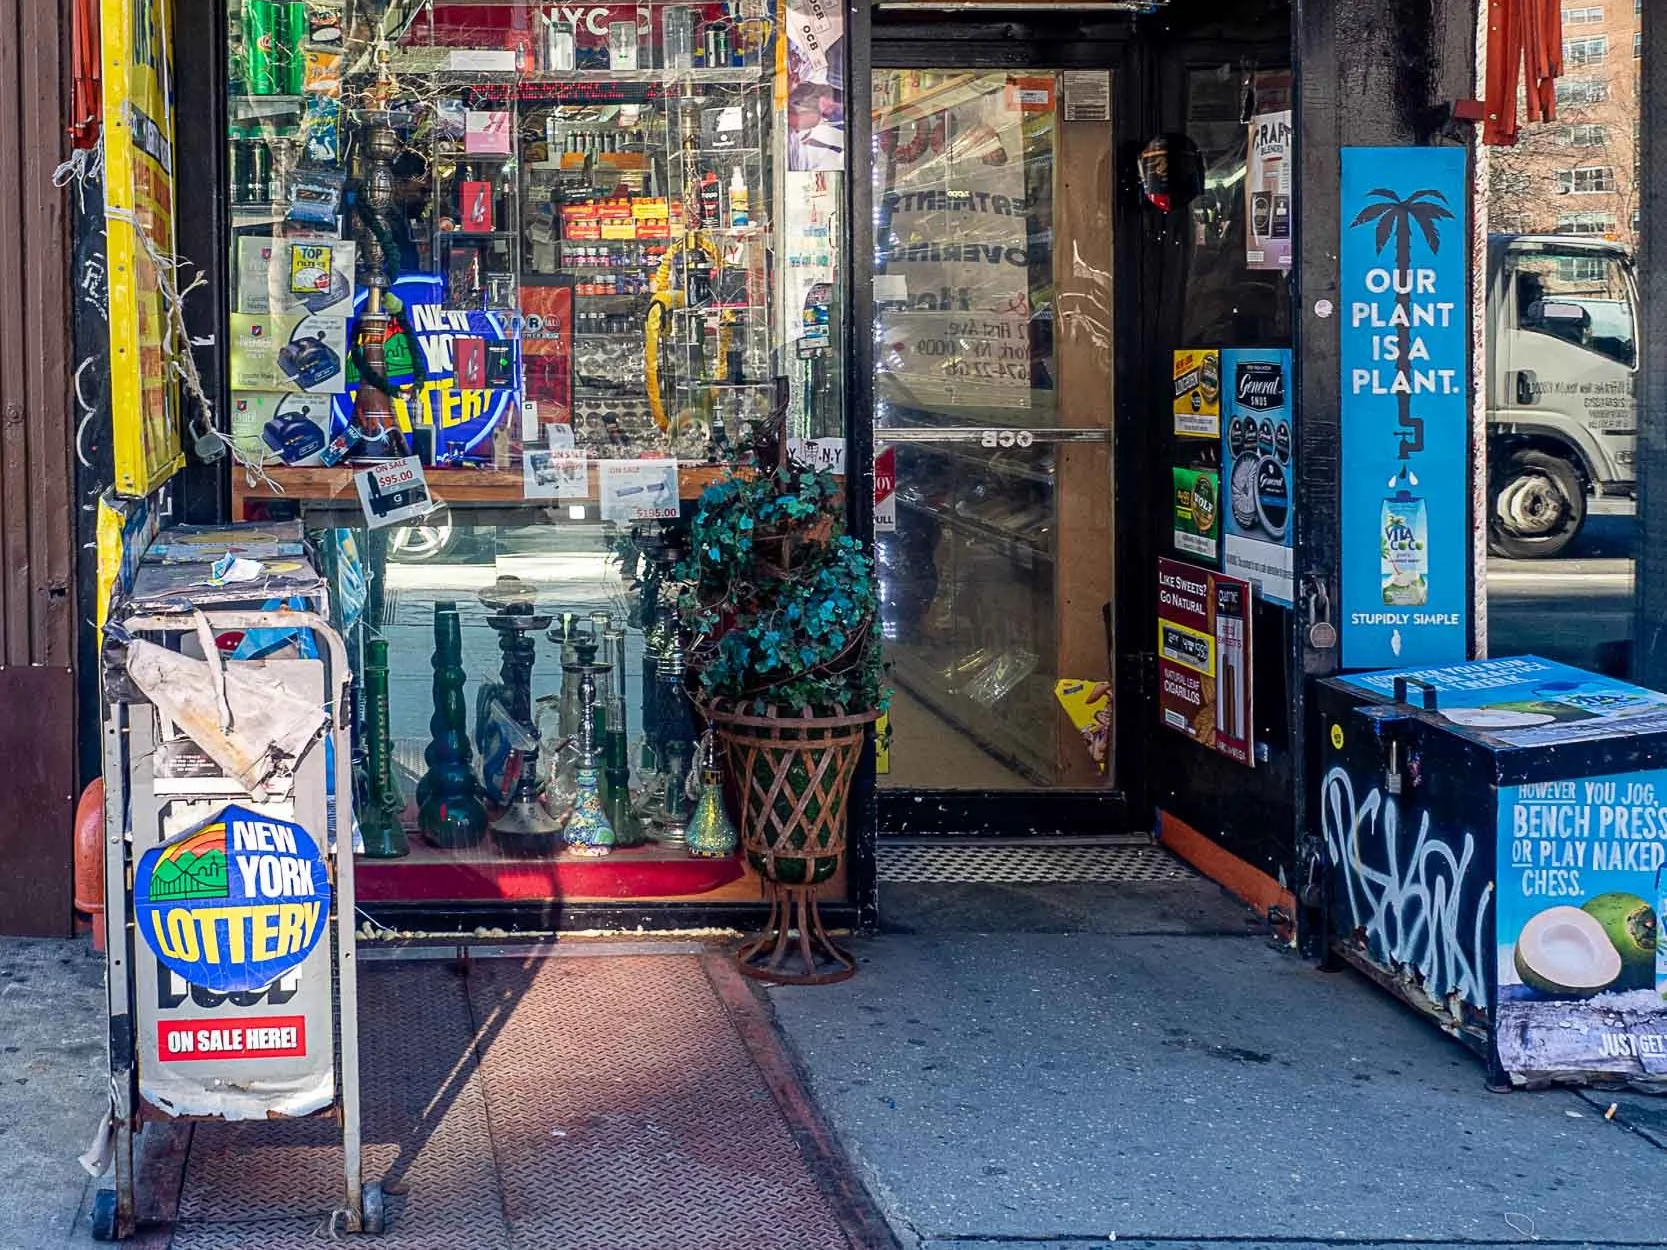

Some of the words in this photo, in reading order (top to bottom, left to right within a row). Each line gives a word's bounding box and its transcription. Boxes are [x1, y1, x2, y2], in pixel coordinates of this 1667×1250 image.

[802, 25, 819, 51] OCB
[303, 248, 323, 259] TOP
[1365, 268, 1437, 295] OUR
[412, 304, 471, 332] NEW
[1352, 302, 1455, 328] PLANT
[418, 333, 484, 373] YO
[1372, 335, 1400, 361] IS
[1408, 336, 1431, 361] A
[1238, 373, 1281, 399] General
[1352, 368, 1460, 395] PLANT.
[1251, 396, 1268, 407] SNUS
[375, 465, 388, 474] ON
[389, 459, 409, 470] SALE
[379, 470, 413, 487] $95.00
[874, 515, 894, 525] ULL
[1159, 572, 1176, 590] LIKE
[1176, 576, 1207, 598] SWEETS?
[1160, 590, 1172, 605] GO
[1351, 613, 1410, 625] STUPIDLY
[1413, 613, 1460, 625] SIMPLE
[1164, 668, 1187, 688] NATURAL
[1187, 676, 1201, 690] LEAF
[1164, 680, 1200, 705] CIGARILLOS
[1518, 781, 1576, 799] HOWEVER
[1584, 781, 1617, 805] YOU
[1621, 782, 1659, 807] JOG,
[1513, 804, 1591, 839] BENCH
[232, 820, 298, 854] NEW
[1512, 839, 1533, 863] OR
[1539, 840, 1587, 867] PLAY
[1592, 841, 1665, 872] NAKED
[235, 854, 315, 898] YORK
[1521, 869, 1585, 897] CHESS.
[151, 901, 321, 964] LOTTERY
[167, 1031, 194, 1053] ON
[197, 1029, 244, 1052] SALE
[246, 1027, 297, 1050] HERE!
[1599, 1034, 1638, 1057] JUST
[1640, 1035, 1665, 1054] GET
